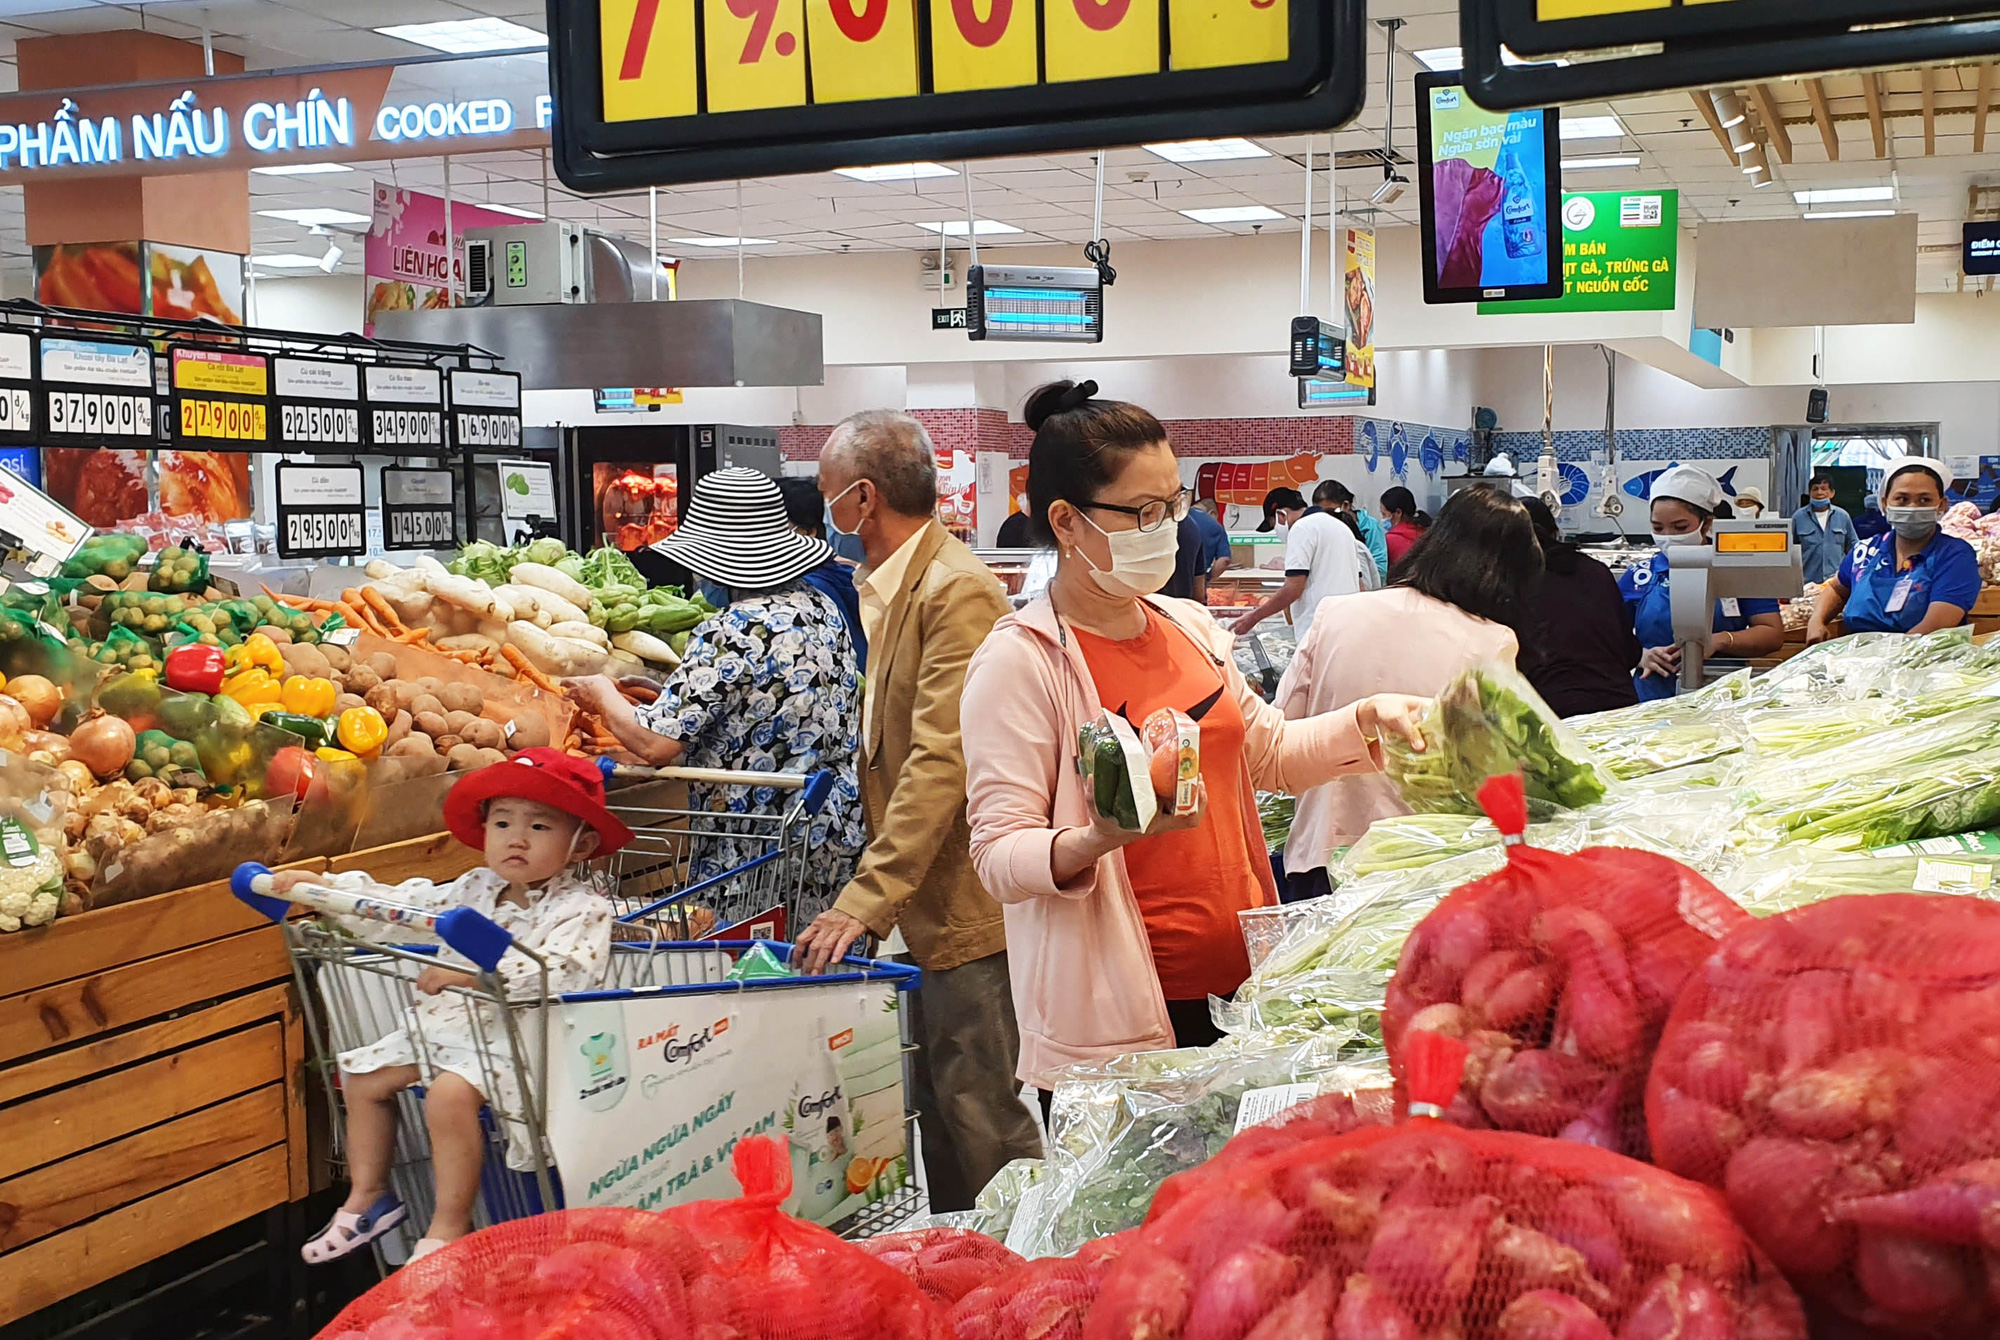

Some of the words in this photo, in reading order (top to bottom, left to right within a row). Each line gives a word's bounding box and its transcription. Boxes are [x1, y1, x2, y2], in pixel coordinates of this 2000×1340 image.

[0, 97, 118, 168] PHẨM
[131, 90, 225, 160] NẤU
[243, 87, 350, 152] CHÍN
[377, 98, 512, 140] COOKED
[1443, 127, 1478, 143] Ngăn
[1480, 124, 1505, 138] bạc
[1507, 117, 1537, 132] màu
[1437, 141, 1473, 157] Ngừa
[1506, 203, 1531, 214] Comfort
[1564, 243, 1576, 256] M
[1579, 240, 1607, 256] BÁN
[393, 245, 424, 276] LIÊN
[1563, 262, 1577, 277] ỊT
[1581, 259, 1602, 276] GÀ,
[1605, 257, 1649, 273] TRỨNG
[1651, 256, 1669, 272] GÀ
[1564, 281, 1573, 293] T
[1576, 275, 1620, 293] NGUỒN
[1622, 274, 1649, 292] GỐC
[53, 398, 131, 427] 37.900
[184, 404, 251, 432] 27.900
[285, 411, 344, 434] 22.500
[376, 415, 428, 437] 34.900
[461, 418, 508, 439] 16.900
[290, 518, 348, 542] 29.500
[393, 516, 442, 535] 14.500
[664, 1028, 713, 1065] Comfort
[799, 1086, 842, 1119] Comfort
[702, 1155, 713, 1173] &
